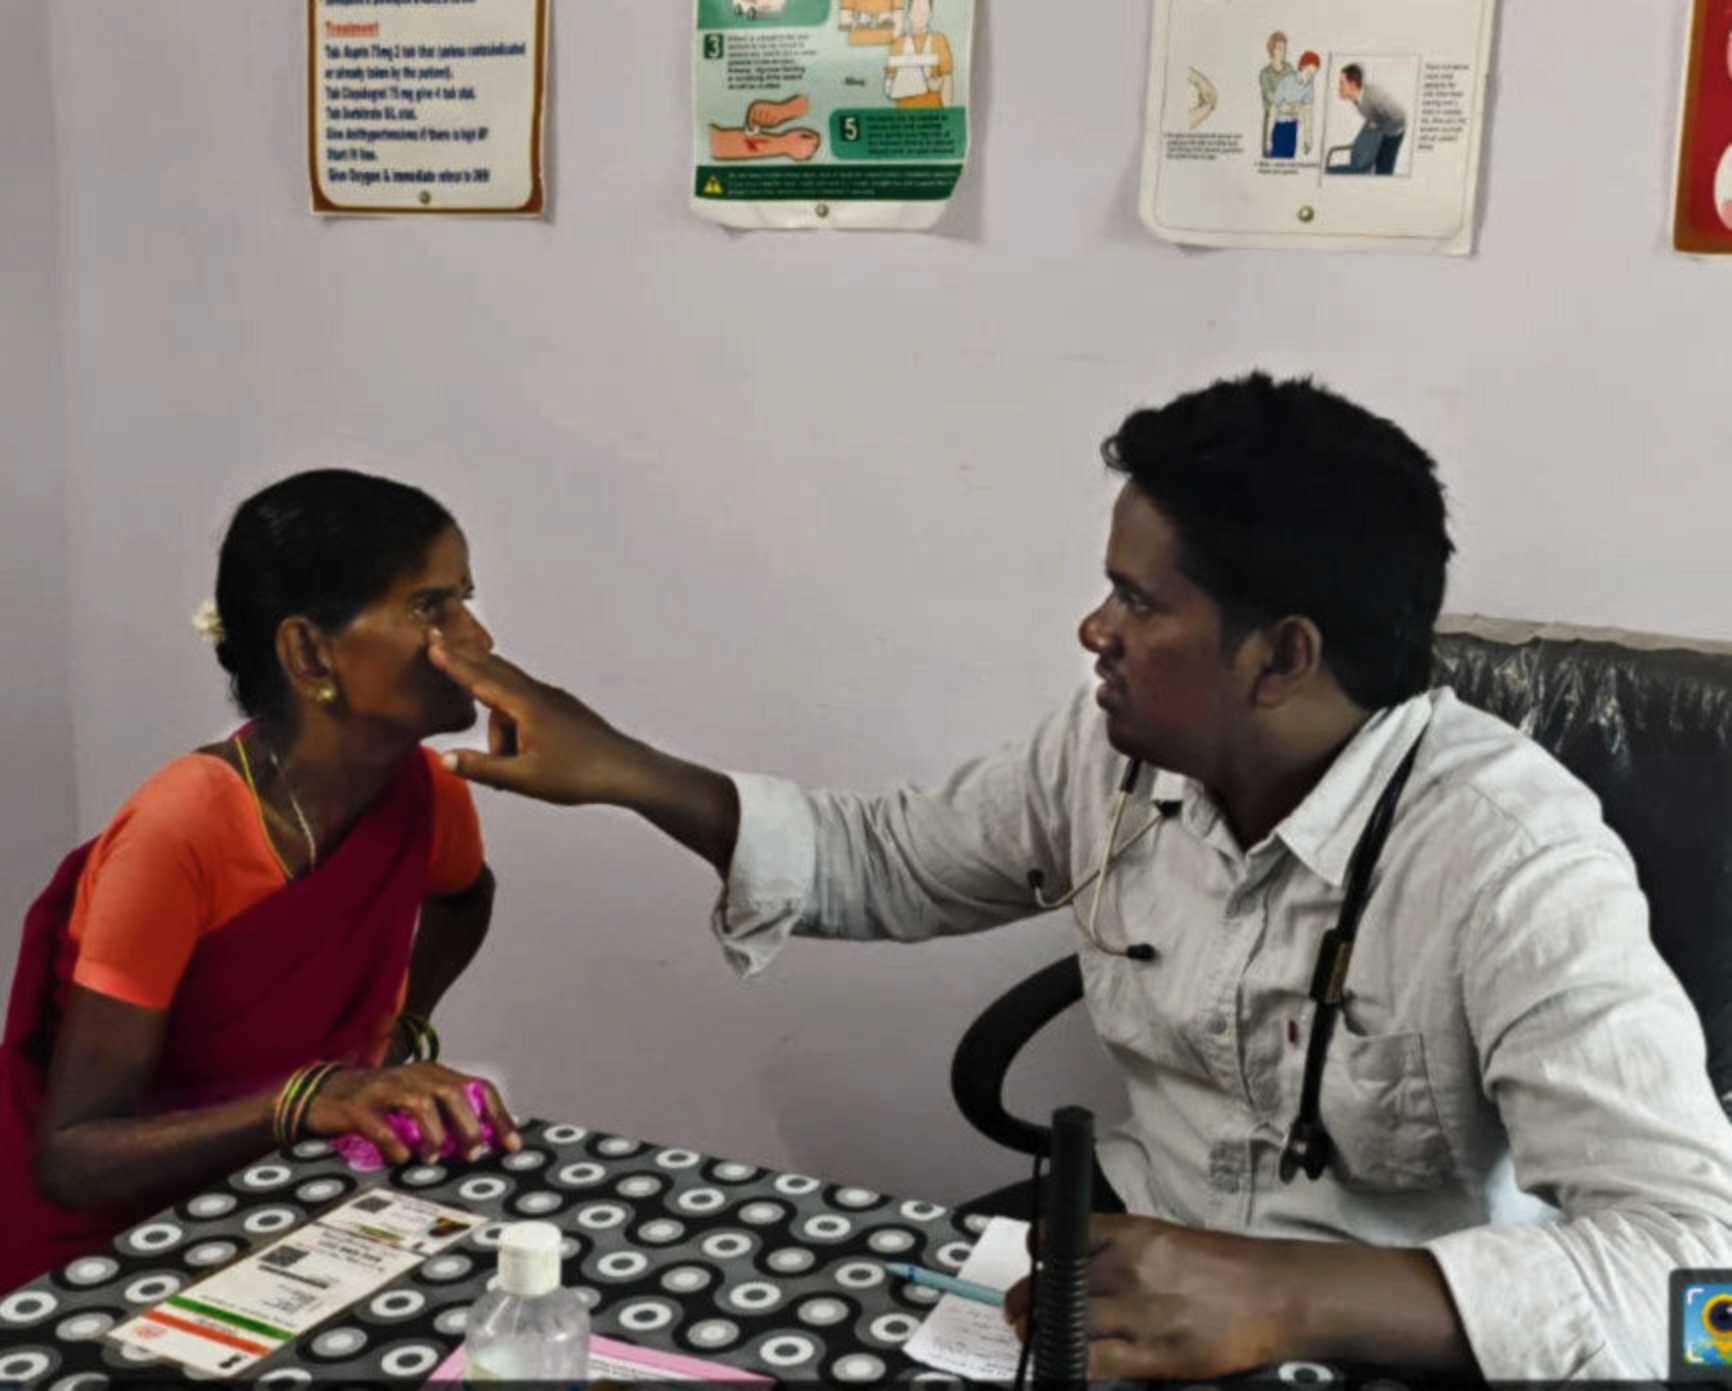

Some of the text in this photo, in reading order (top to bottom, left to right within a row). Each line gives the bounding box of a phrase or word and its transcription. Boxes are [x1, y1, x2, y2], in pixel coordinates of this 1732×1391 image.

[325, 20, 379, 34] Treatment
[708, 36, 719, 57] 3
[335, 66, 364, 82] already
[366, 66, 388, 79] taken
[390, 66, 401, 82] by
[403, 66, 416, 79] the
[428, 127, 451, 141] there
[461, 128, 477, 144] high
[845, 118, 857, 140] 5
[348, 167, 381, 186] Oxygen
